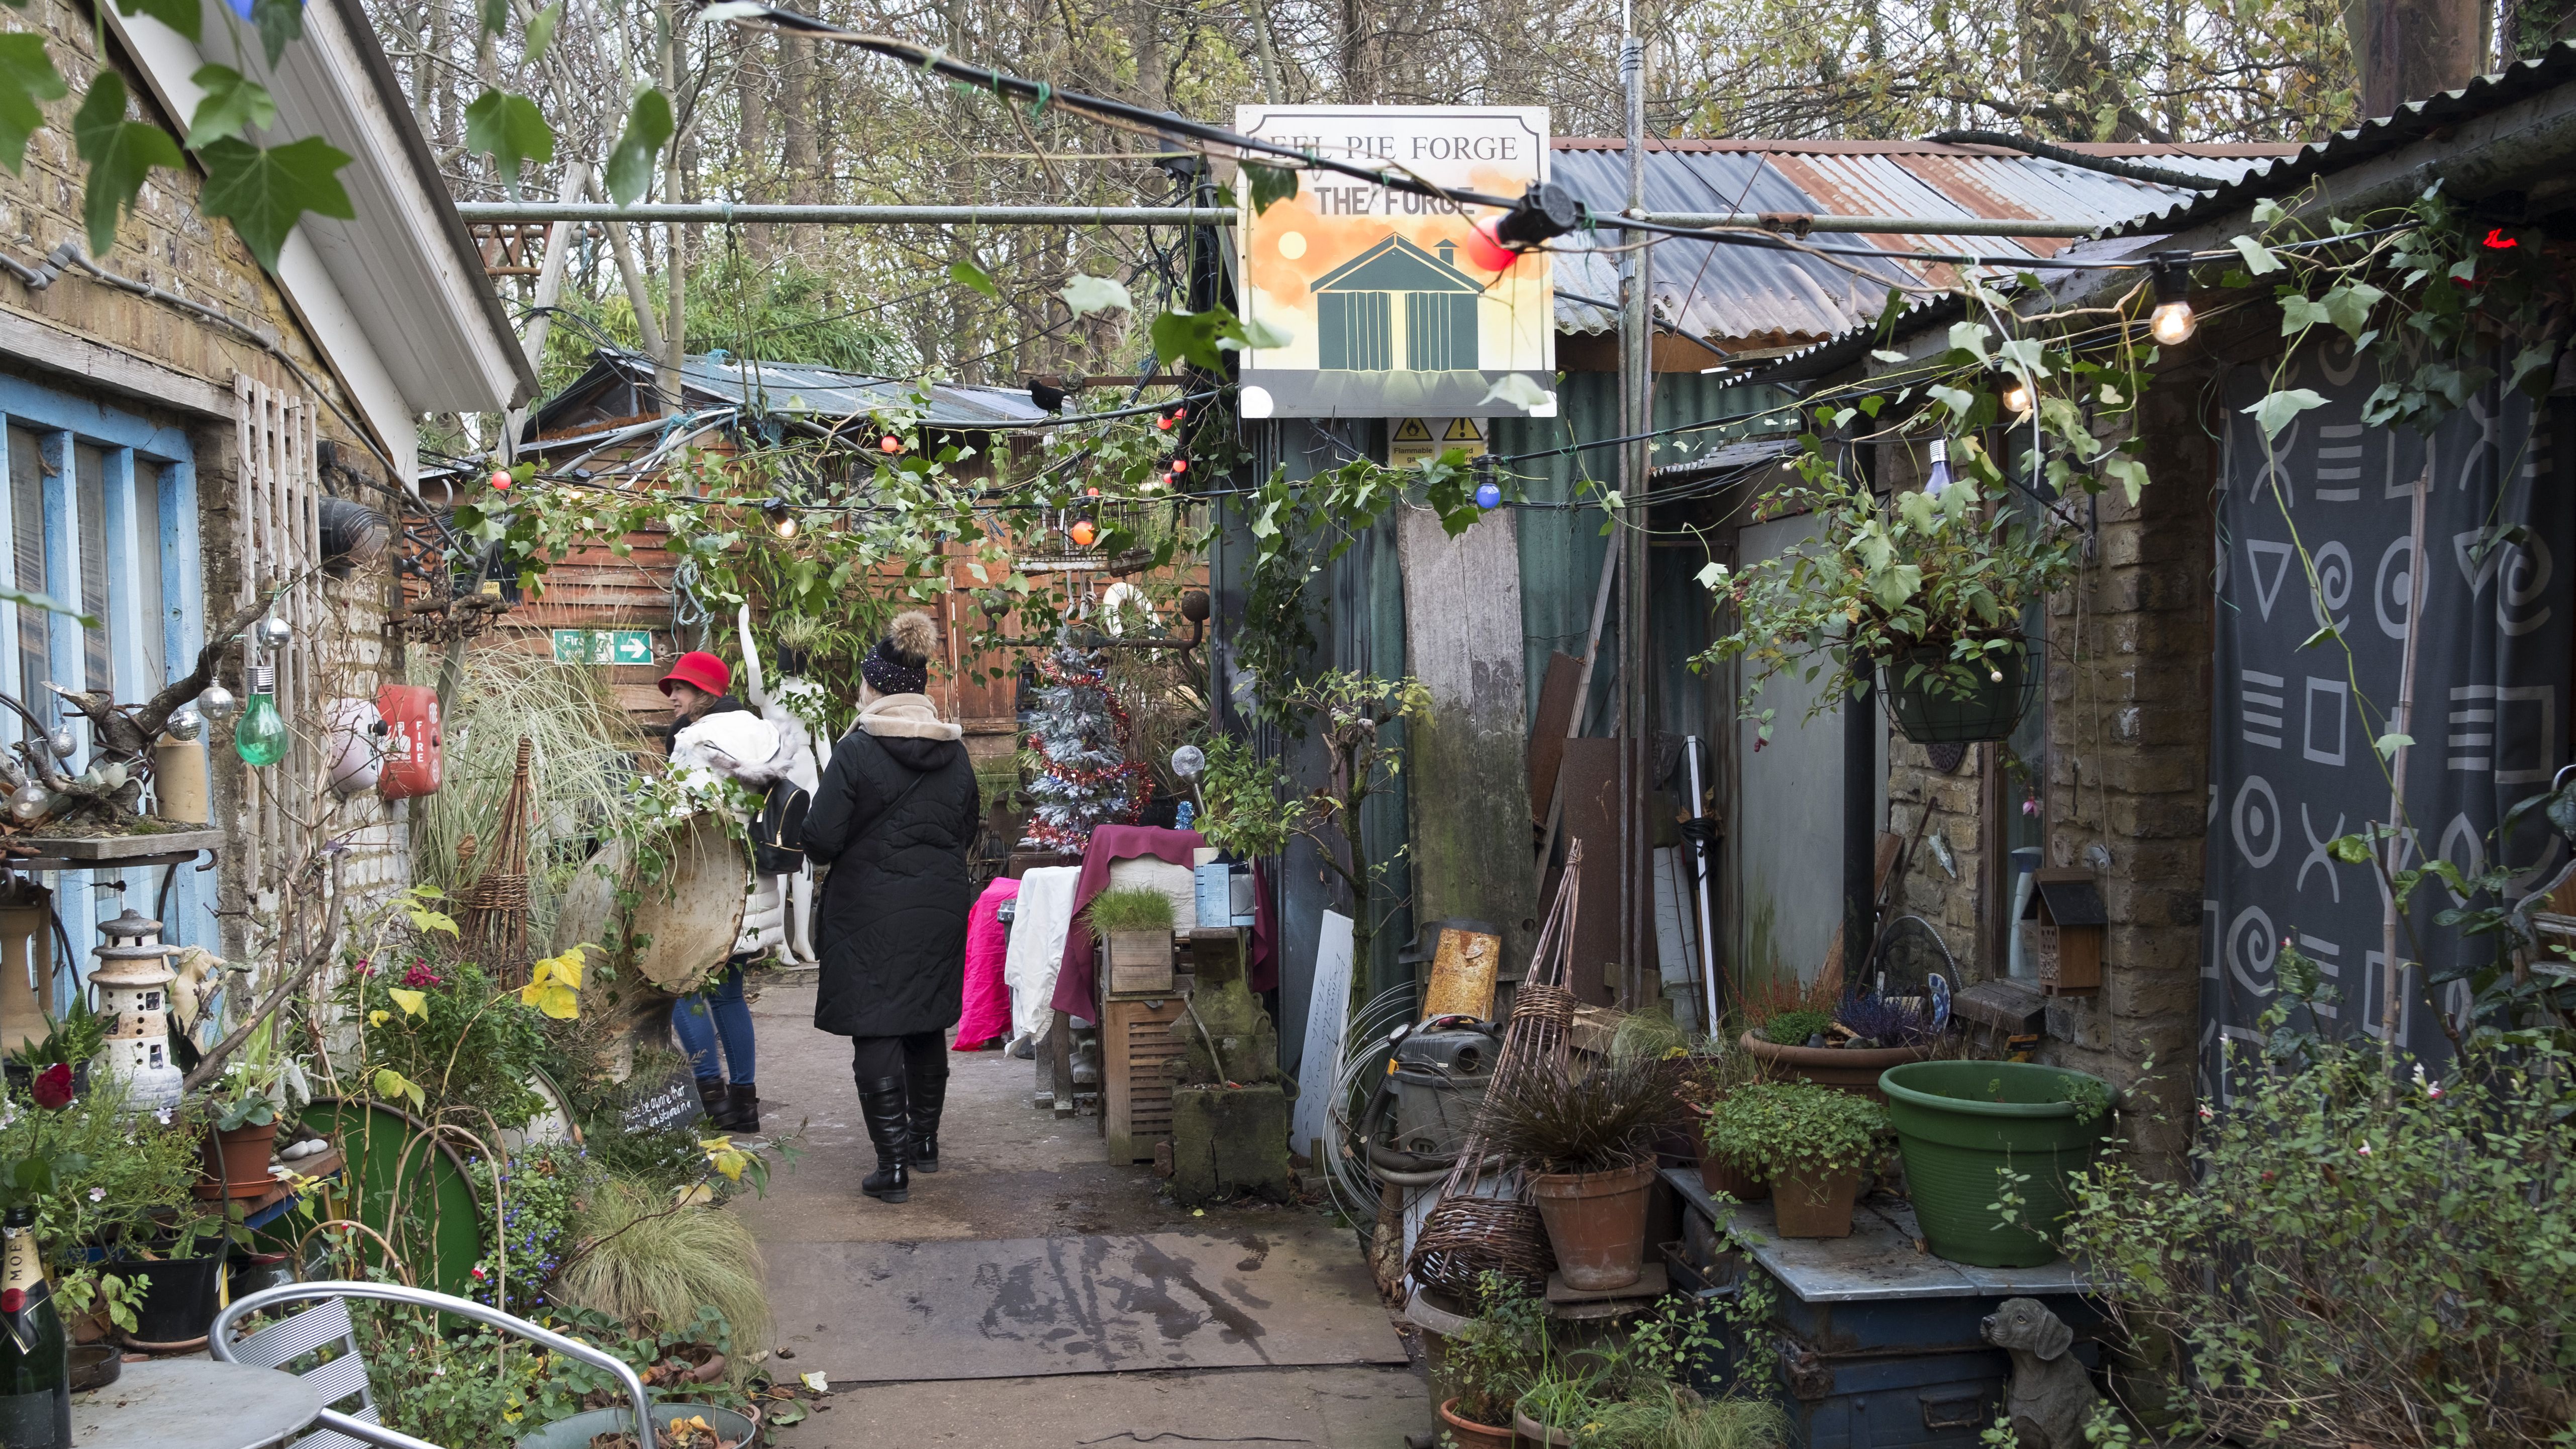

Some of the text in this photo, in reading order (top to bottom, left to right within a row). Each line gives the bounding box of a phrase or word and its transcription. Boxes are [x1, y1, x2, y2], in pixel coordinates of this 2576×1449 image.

[1345, 136, 1396, 159] PIE
[1411, 136, 1518, 160] FORGE
[1314, 187, 1369, 215] THE
[564, 635, 584, 646] Fire
[416, 721, 424, 762] FIRE
[1311, 973, 1325, 1045] Thank
[650, 1094, 672, 1109] aware
[686, 1101, 691, 1109] a
